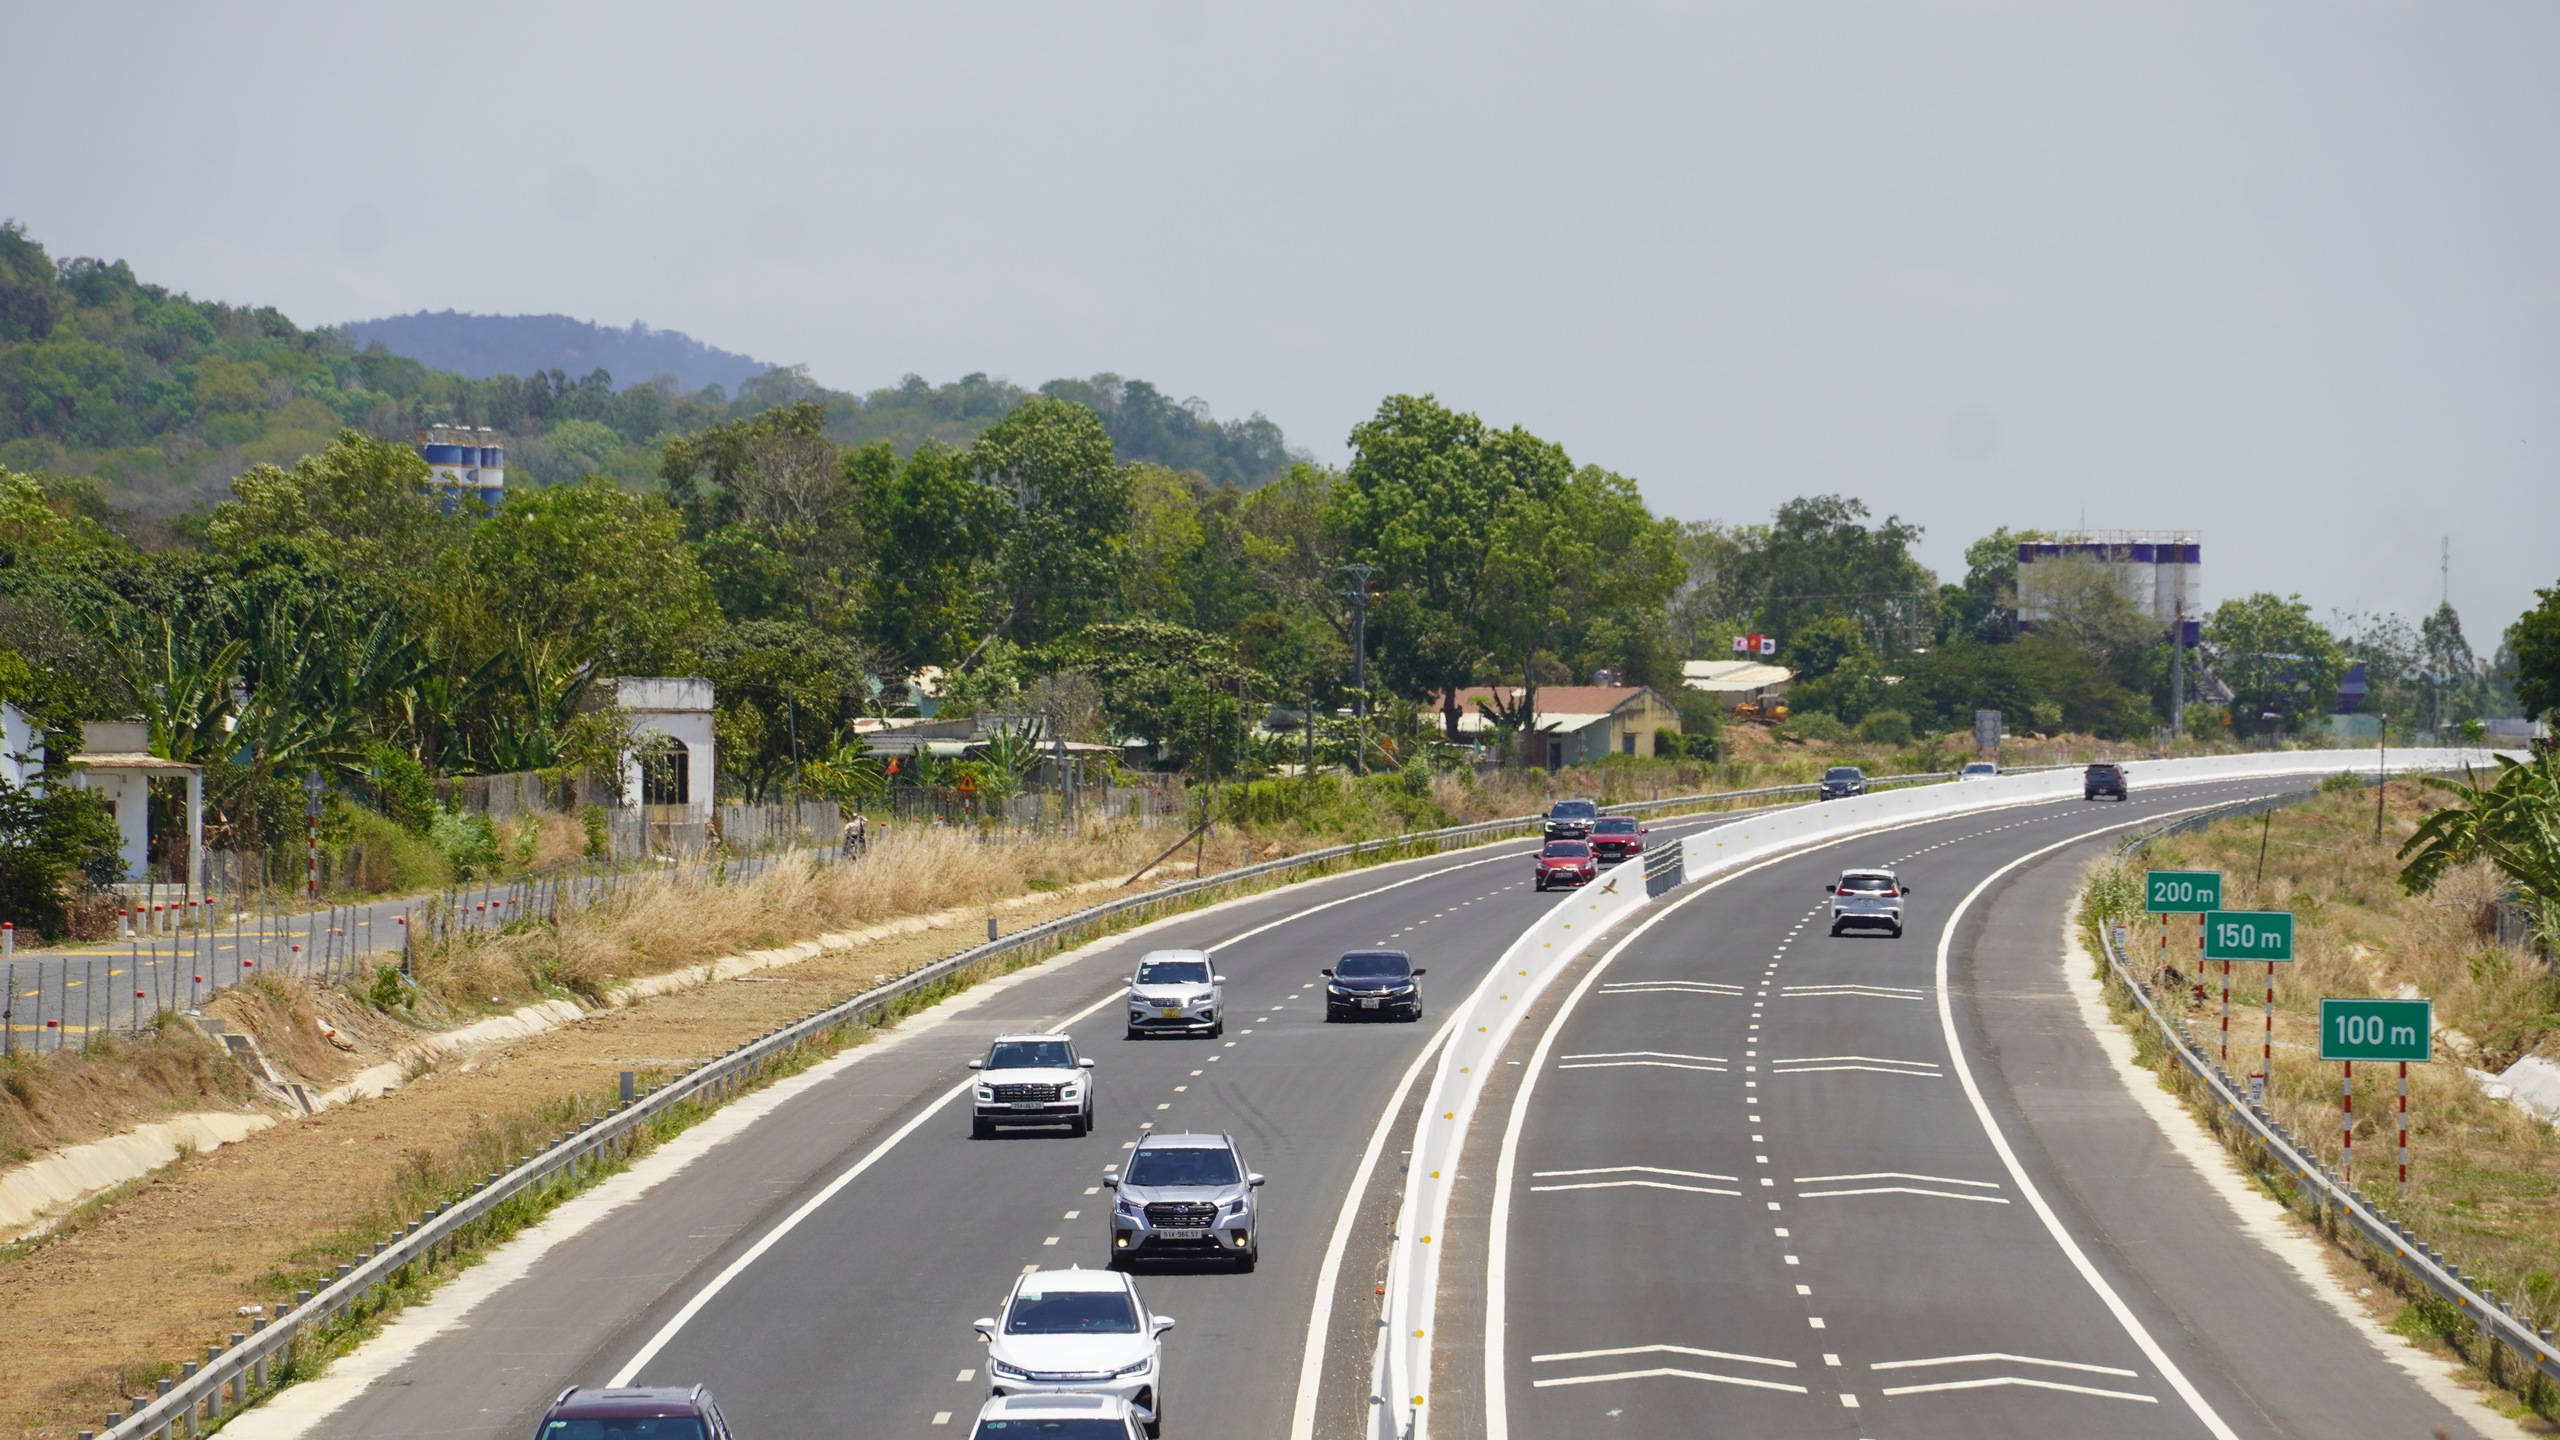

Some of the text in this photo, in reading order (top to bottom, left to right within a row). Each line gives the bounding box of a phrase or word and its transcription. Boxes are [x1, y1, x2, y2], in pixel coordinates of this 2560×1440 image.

[2154, 881, 2214, 902] 200 m
[2217, 923, 2281, 948] 150 m
[2336, 1015, 2415, 1045] 100 m
